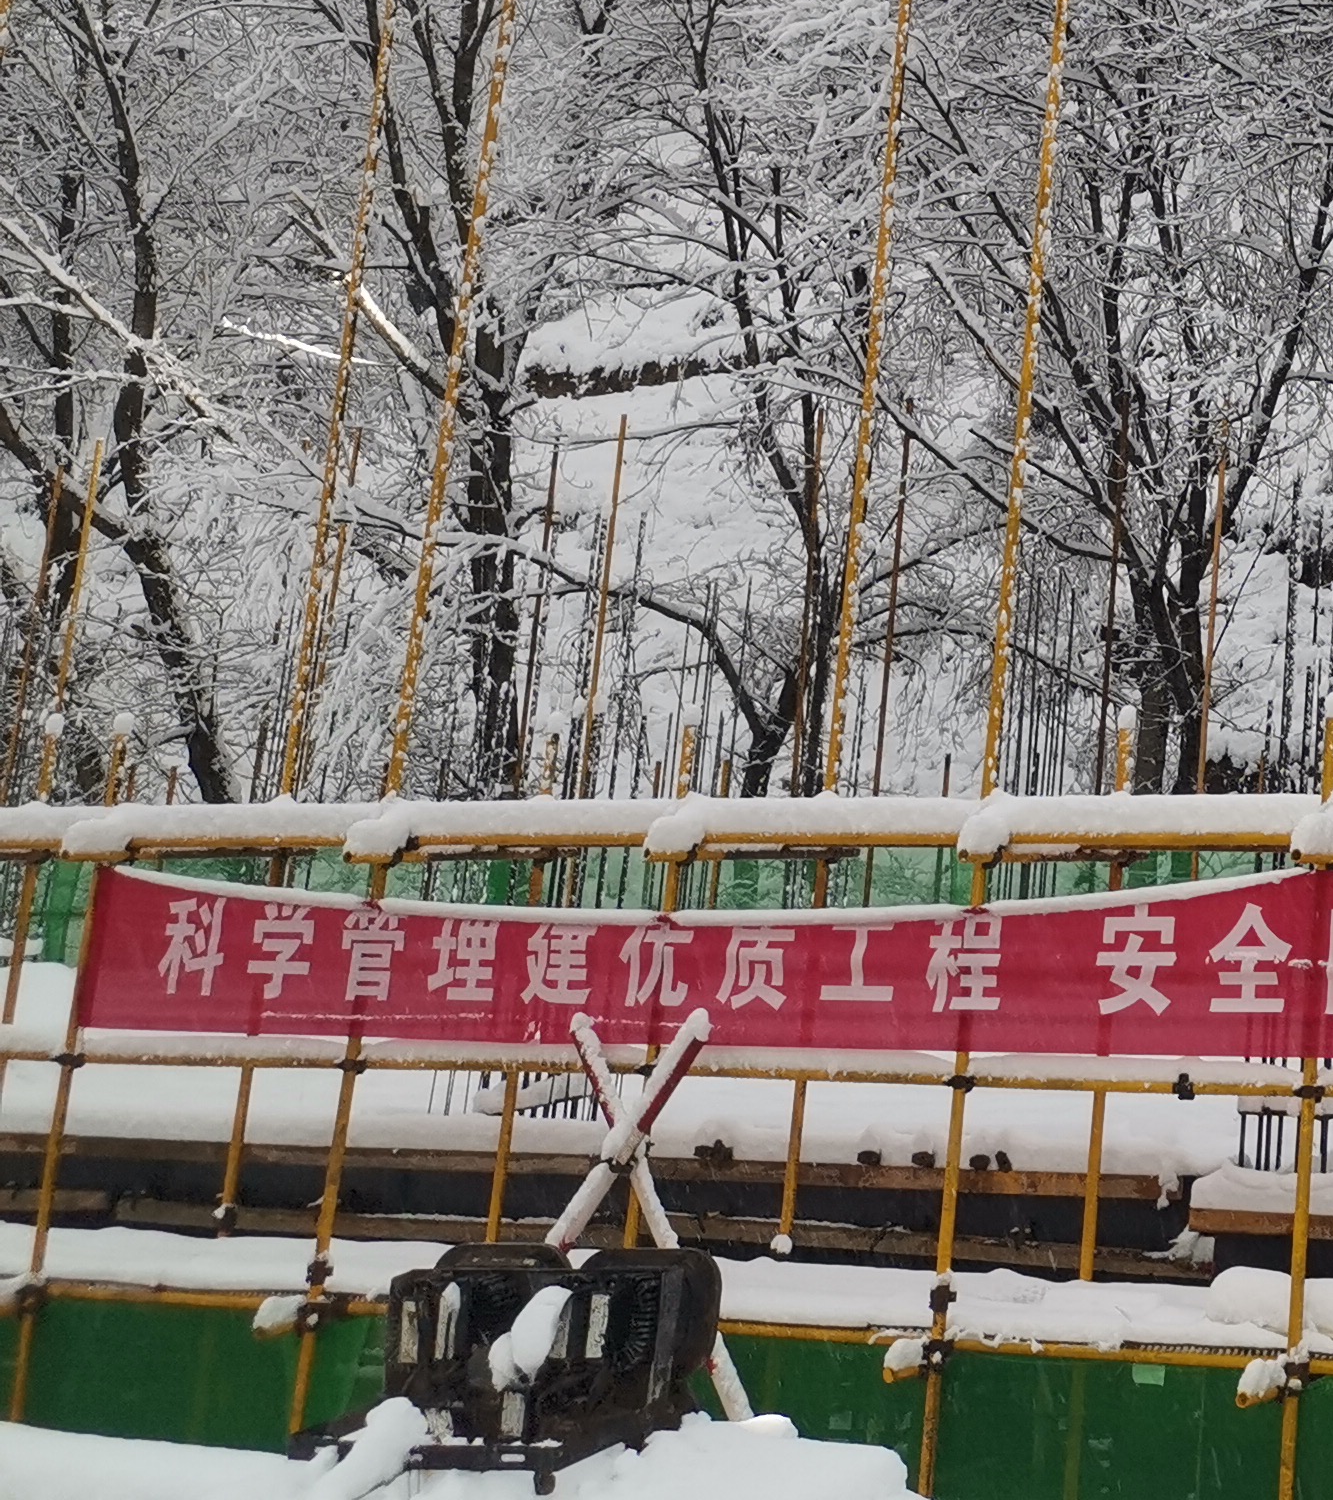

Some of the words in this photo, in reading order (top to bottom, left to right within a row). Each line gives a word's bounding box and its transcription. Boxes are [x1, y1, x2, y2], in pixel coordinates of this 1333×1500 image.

[158, 897, 1001, 1012] 科学管理建优质工程
